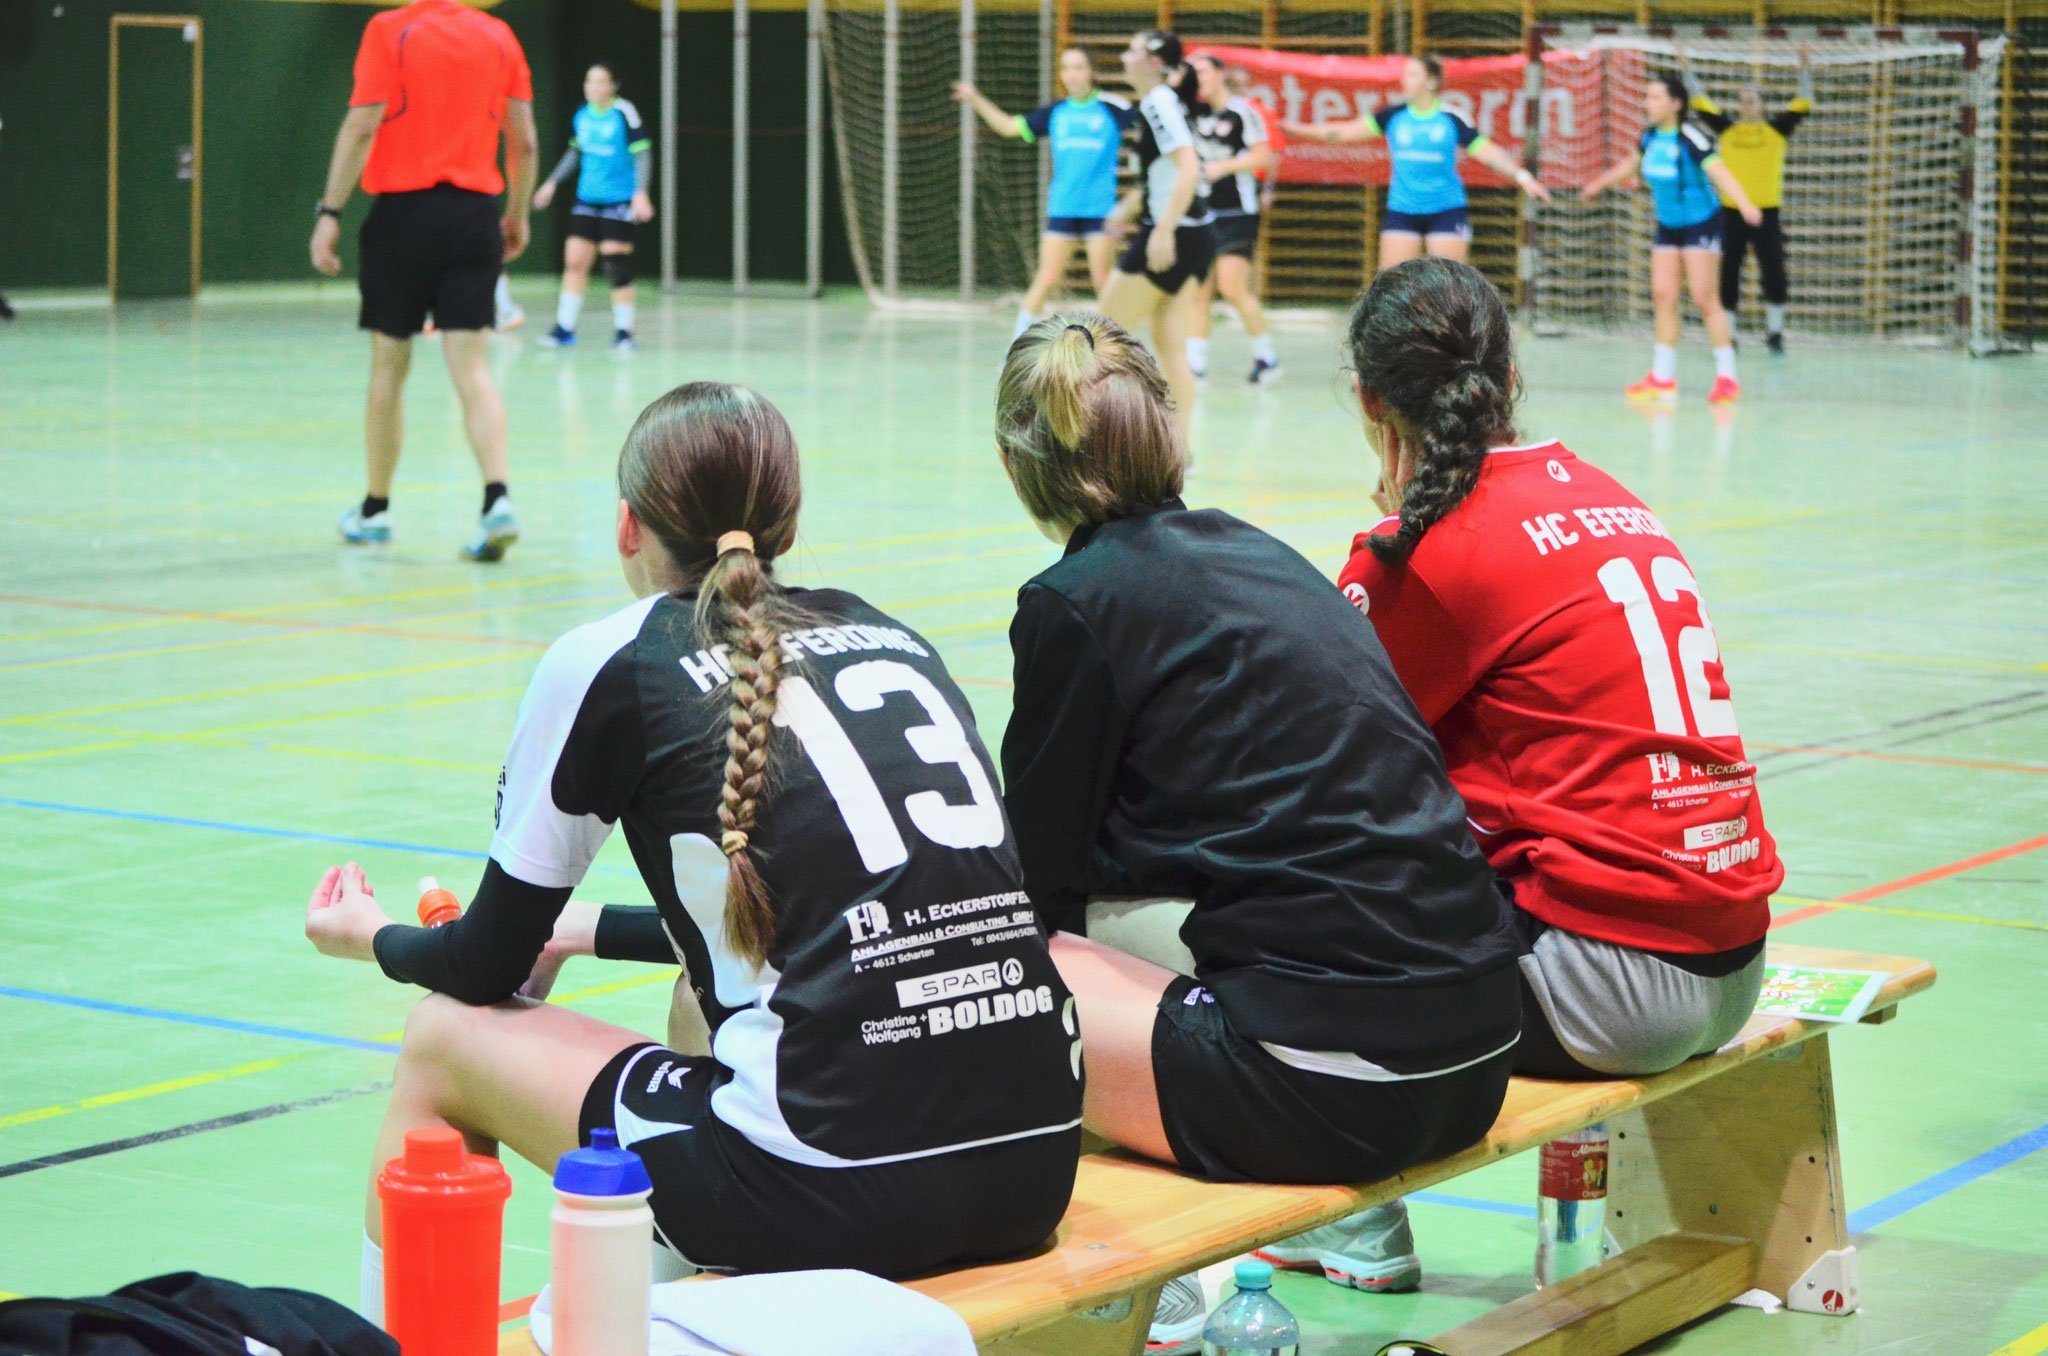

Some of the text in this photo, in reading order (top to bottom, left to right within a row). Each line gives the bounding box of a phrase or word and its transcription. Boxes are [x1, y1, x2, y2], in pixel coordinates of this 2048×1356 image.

[1521, 512, 1580, 556] HC
[781, 624, 929, 664] FERDING
[1598, 555, 1740, 738] 12
[771, 659, 1005, 873] 13
[1690, 764, 1705, 778] H.
[1652, 802, 1659, 811] A
[1667, 799, 1684, 809] 4612
[1701, 823, 1739, 843] SPAR
[1706, 836, 1760, 874] BOLDOG
[903, 908, 927, 927] H.
[850, 930, 935, 962] ANLAGENBAU
[934, 926, 946, 940] &
[945, 913, 1009, 937] CONSULTING
[854, 964, 863, 974] A
[872, 956, 896, 970] 4612
[898, 948, 936, 964] Scharten
[921, 968, 999, 997] SPAR
[861, 1012, 917, 1034] Christine
[928, 985, 1054, 1036] BOLDOG
[862, 1027, 922, 1046] Wolfgang
